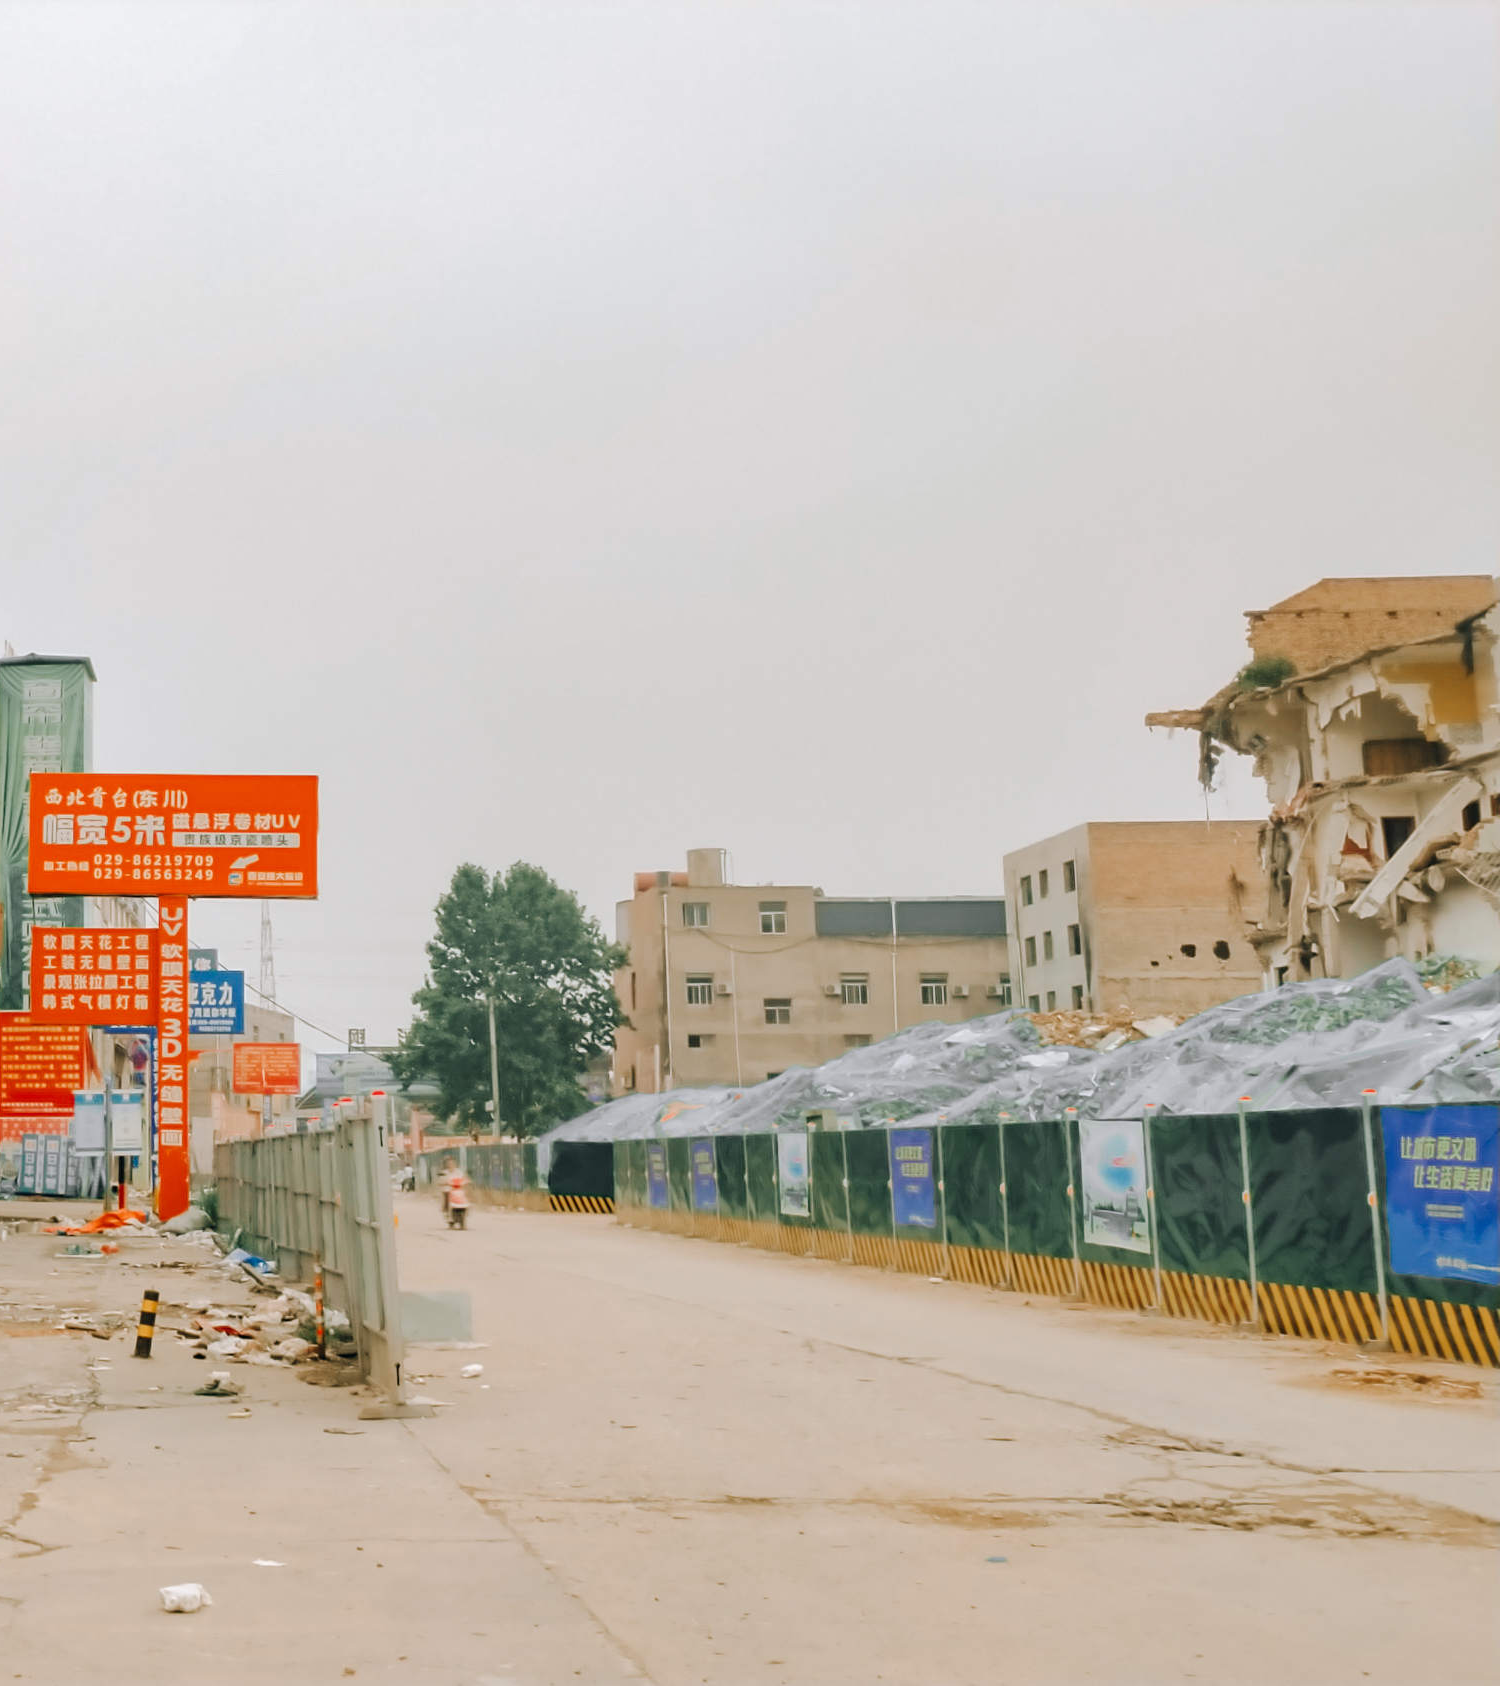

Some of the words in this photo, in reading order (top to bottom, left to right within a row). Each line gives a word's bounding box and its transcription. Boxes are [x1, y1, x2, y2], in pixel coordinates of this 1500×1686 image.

[44, 786, 188, 809] 西北首台(东川)
[172, 812, 300, 831] 磁悬浮卷材UV
[42, 814, 166, 846] 幅宽5米
[184, 834, 289, 846] 贵族级京瓷喷头
[43, 860, 90, 872] 加工热线
[93, 854, 214, 866] 029-86219709
[93, 868, 214, 880] 029-86563249
[42, 934, 149, 950] 软膜天花工程
[42, 954, 149, 970] 工装无缝壁画
[42, 974, 149, 990] 景观张拉膜工程
[42, 993, 149, 1010] 韩式气模灯箱
[1401, 1135, 1477, 1162] 让城市更文明
[1414, 1165, 1493, 1193] 让生活更美好
